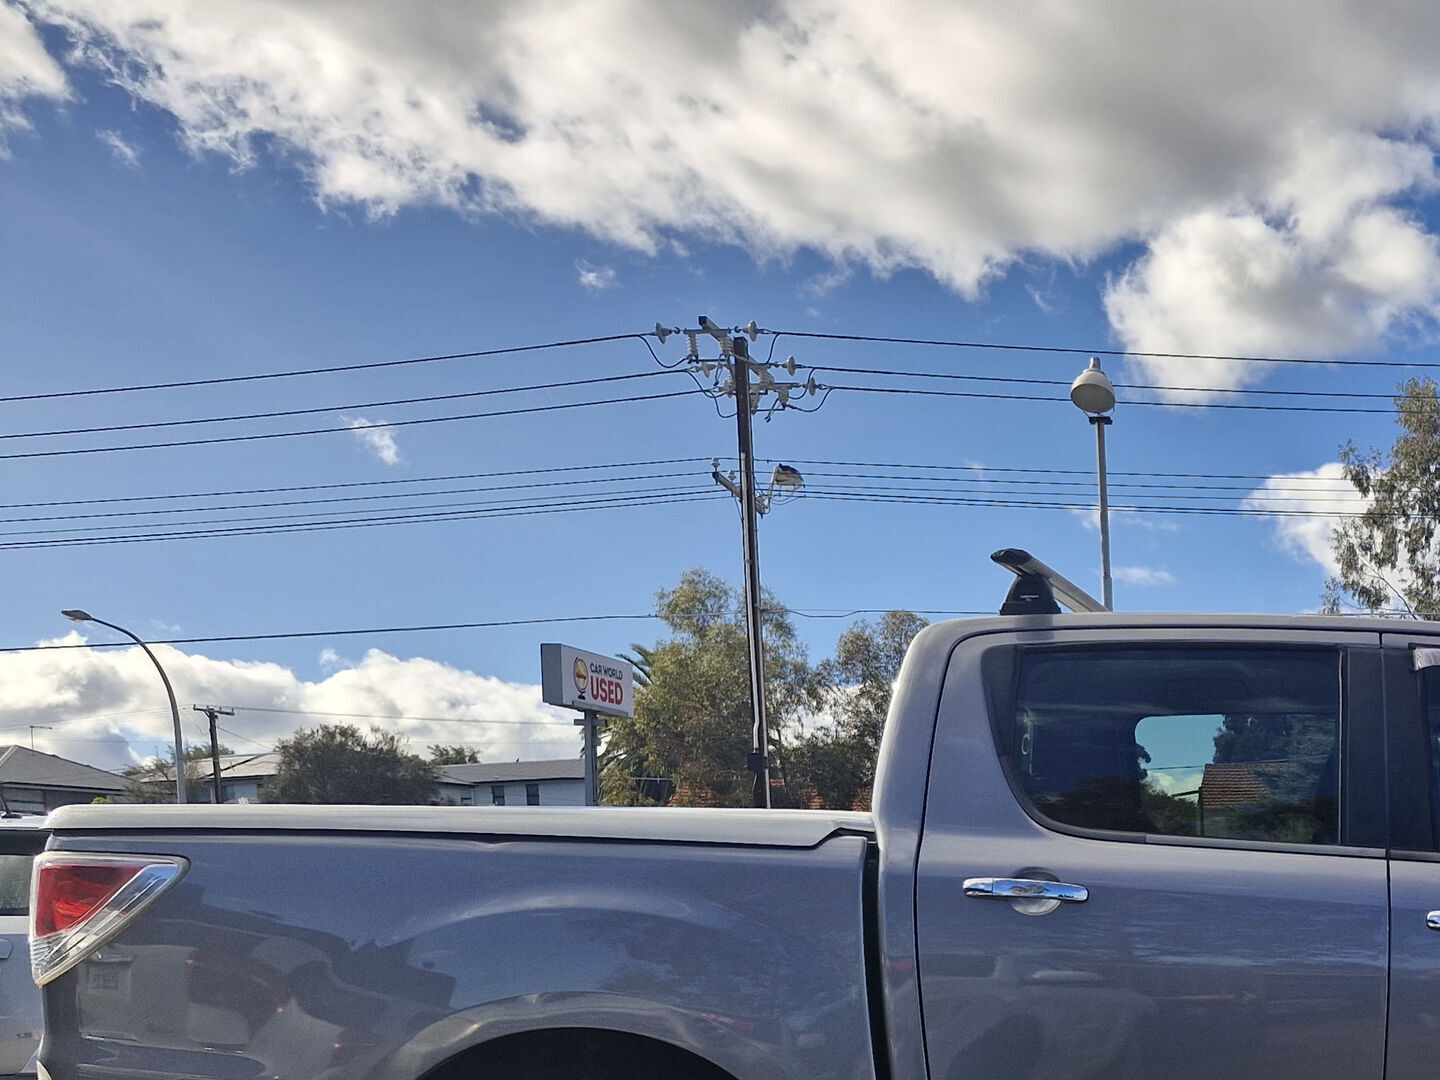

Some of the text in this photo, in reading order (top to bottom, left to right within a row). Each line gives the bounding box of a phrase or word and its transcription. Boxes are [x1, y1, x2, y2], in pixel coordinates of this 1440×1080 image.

[590, 662, 623, 680] CAR WORLD
[590, 676, 623, 705] USED
